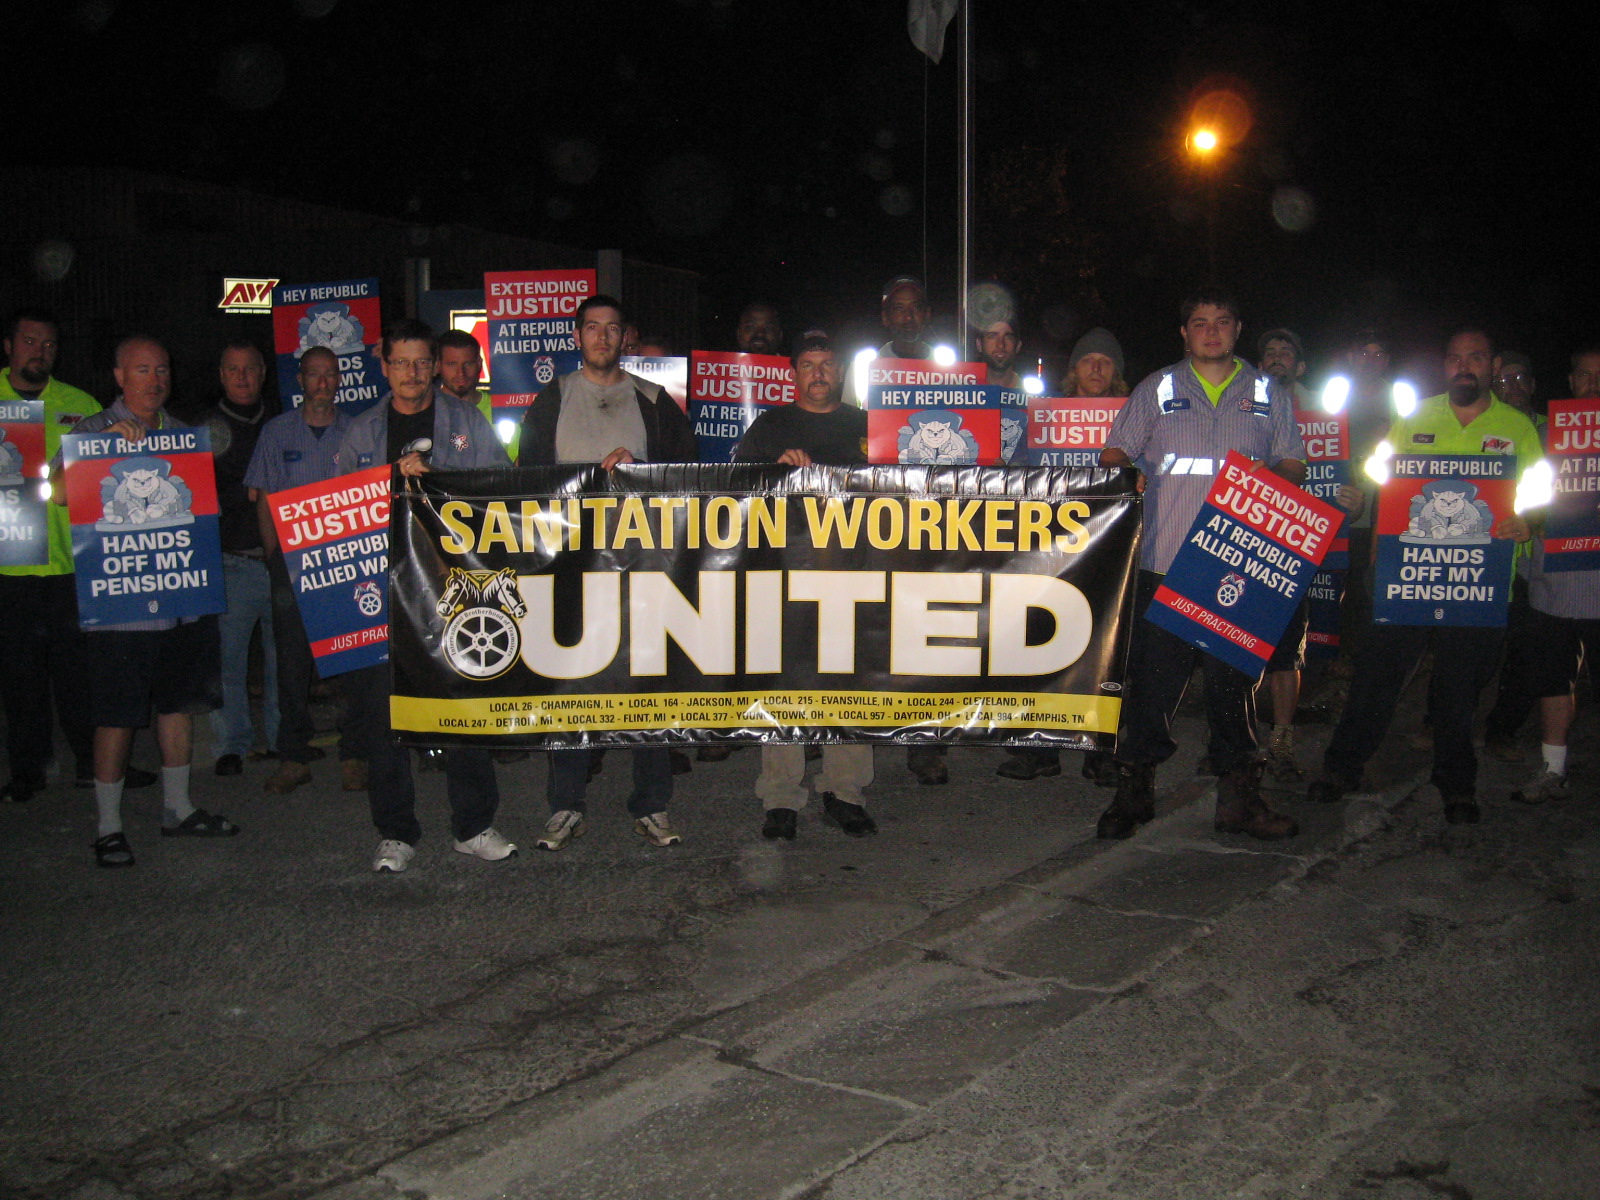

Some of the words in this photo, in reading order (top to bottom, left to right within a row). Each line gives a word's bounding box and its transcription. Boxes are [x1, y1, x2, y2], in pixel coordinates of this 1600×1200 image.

[283, 289, 307, 303] HEY
[310, 283, 369, 300] REPUBLIC
[490, 280, 589, 296] EXTENDING
[499, 323, 518, 337] AT
[521, 320, 576, 336] REPUBLI
[494, 339, 540, 355] ALLIED
[543, 337, 581, 351] WAS
[869, 369, 977, 386] EXTENDING
[506, 394, 529, 405] JUST
[695, 379, 796, 403] JUSTICE
[881, 390, 911, 405] HEY
[915, 390, 987, 406] REPUBLIC
[700, 405, 717, 419] AT
[1034, 409, 1120, 423] EXTENDI
[694, 421, 739, 438] ALLIED
[1034, 426, 1112, 445] JUSTI
[78, 438, 112, 456] HEY
[116, 433, 197, 454] REPUBLIC
[1040, 453, 1060, 466] AT
[1063, 452, 1100, 466] REPU
[1395, 460, 1426, 475] HEY
[1429, 460, 1503, 476] REPUBLIC
[1559, 458, 1583, 474] AT
[1301, 483, 1341, 498] ASTE
[1553, 476, 1600, 493] ALLIE
[278, 479, 391, 522] EXTENDIN
[1224, 465, 1330, 534] EXTENDING
[287, 500, 391, 546] JUSTIC
[439, 496, 787, 555] SANITATION
[803, 496, 1091, 555] WORKERS
[1214, 486, 1322, 557] JUSTICE
[102, 530, 192, 554] HANDS
[302, 549, 322, 570] AT
[326, 532, 389, 564] REPUB
[1207, 514, 1233, 533] AT
[1234, 525, 1302, 577] REPUBLIC
[1562, 538, 1591, 551] JUST
[103, 554, 149, 575] OFF
[156, 550, 195, 571] MY
[1191, 529, 1246, 568] ALLIED
[1244, 557, 1299, 598] WASTE
[1402, 547, 1485, 565] HANDS
[301, 563, 357, 593] ALLIED
[1399, 565, 1442, 582] OFF
[1447, 567, 1485, 583] MY
[91, 569, 209, 598] PENSION!
[1386, 584, 1495, 602] PENSION!
[516, 570, 1093, 680] UNITED
[1170, 597, 1200, 620] JUST
[1197, 610, 1257, 650] PRACTICING
[331, 631, 360, 651] JUST
[464, 609, 504, 620] Brotherhood
[507, 624, 516, 657] Teamsters
[489, 702, 520, 712] LOCAL
[522, 702, 533, 711] 26
[541, 700, 603, 710] CHAMPAIGN,
[605, 699, 614, 708] IL
[628, 698, 659, 708] LOCAL
[664, 698, 678, 707] 164
[686, 697, 735, 707] JACKSON,
[737, 696, 749, 706] MI
[763, 695, 793, 705] LOCAL
[797, 696, 813, 705] 215
[821, 696, 880, 707] EVANSVILLE,
[882, 697, 893, 706] IN
[907, 697, 937, 707] LOCAL
[939, 697, 954, 706] 244
[962, 697, 1020, 707] CLEVELAND,
[1022, 697, 1035, 707] OH
[439, 718, 470, 728] LOCAL
[471, 719, 487, 728] 247
[540, 716, 552, 726] MI
[567, 715, 598, 725] LOCAL
[600, 714, 615, 723] 332
[623, 713, 651, 723] FLINT,
[653, 712, 666, 722] MI
[680, 712, 711, 722] LOCAL
[712, 712, 728, 721] 377
[810, 711, 824, 720] OH
[838, 710, 868, 720] LOCAL
[870, 711, 885, 720] 957
[893, 711, 935, 721] DAYTON,
[937, 711, 950, 720] OH
[997, 712, 1012, 721] 984
[1020, 712, 1070, 724] MEMPHIS,
[1072, 714, 1085, 724] TN
